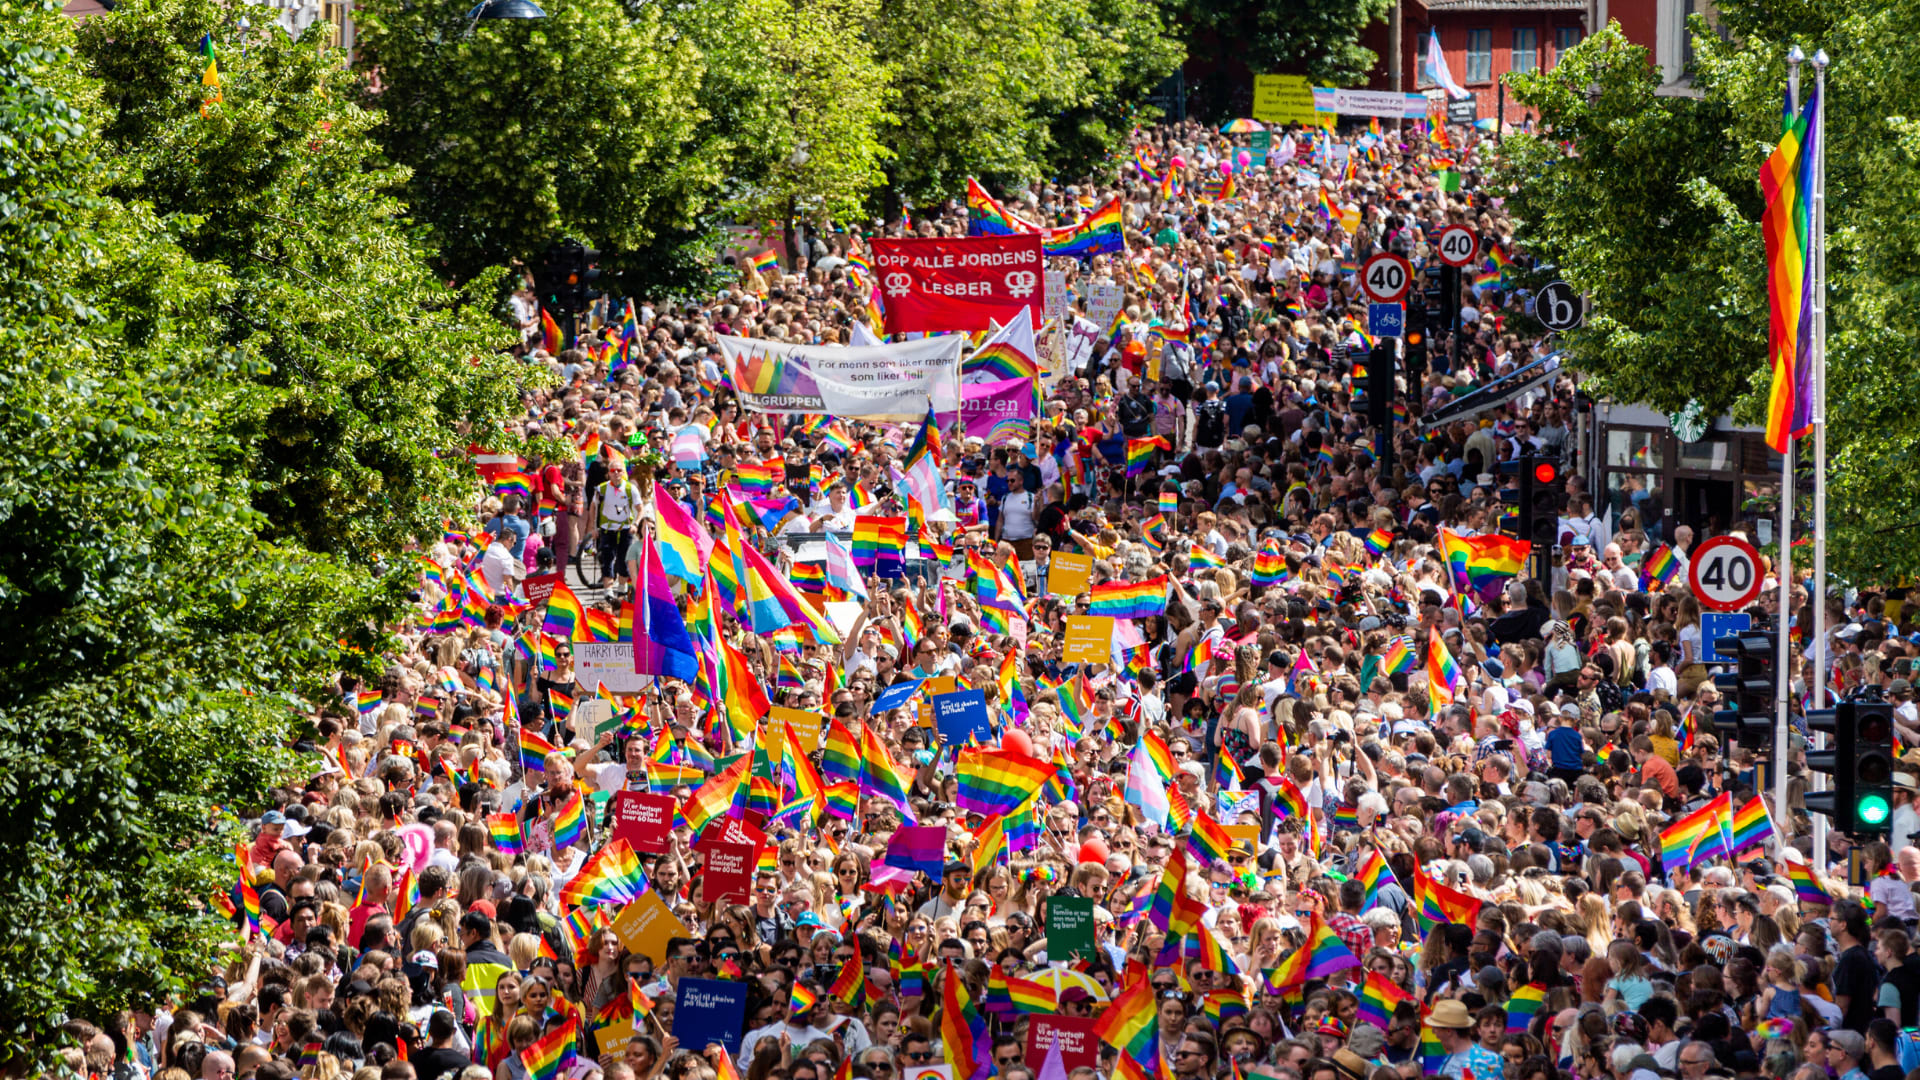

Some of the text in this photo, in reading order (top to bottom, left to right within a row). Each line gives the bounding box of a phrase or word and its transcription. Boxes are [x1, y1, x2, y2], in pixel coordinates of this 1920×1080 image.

[1444, 235, 1471, 255] 40
[877, 250, 1037, 268] OPP ALLE JORDENS
[1369, 265, 1402, 289] 40
[922, 281, 992, 296] LESBER
[1093, 287, 1120, 296] HELT
[1547, 287, 1573, 325] b
[818, 360, 836, 369] For
[872, 361, 896, 369] som
[899, 359, 921, 367] liker
[925, 358, 954, 366] menn
[850, 370, 923, 381] som liker fjell
[1702, 556, 1752, 591] 40
[585, 645, 635, 658] HARRY POTTE
[622, 807, 654, 817] kriminelle
[639, 803, 663, 812] fortsatt
[647, 816, 662, 824] land
[724, 853, 743, 861] fortsatt
[685, 992, 735, 1004] Asyl til skeive
[696, 1000, 715, 1008] flukt!
[1067, 1044, 1084, 1053] land
